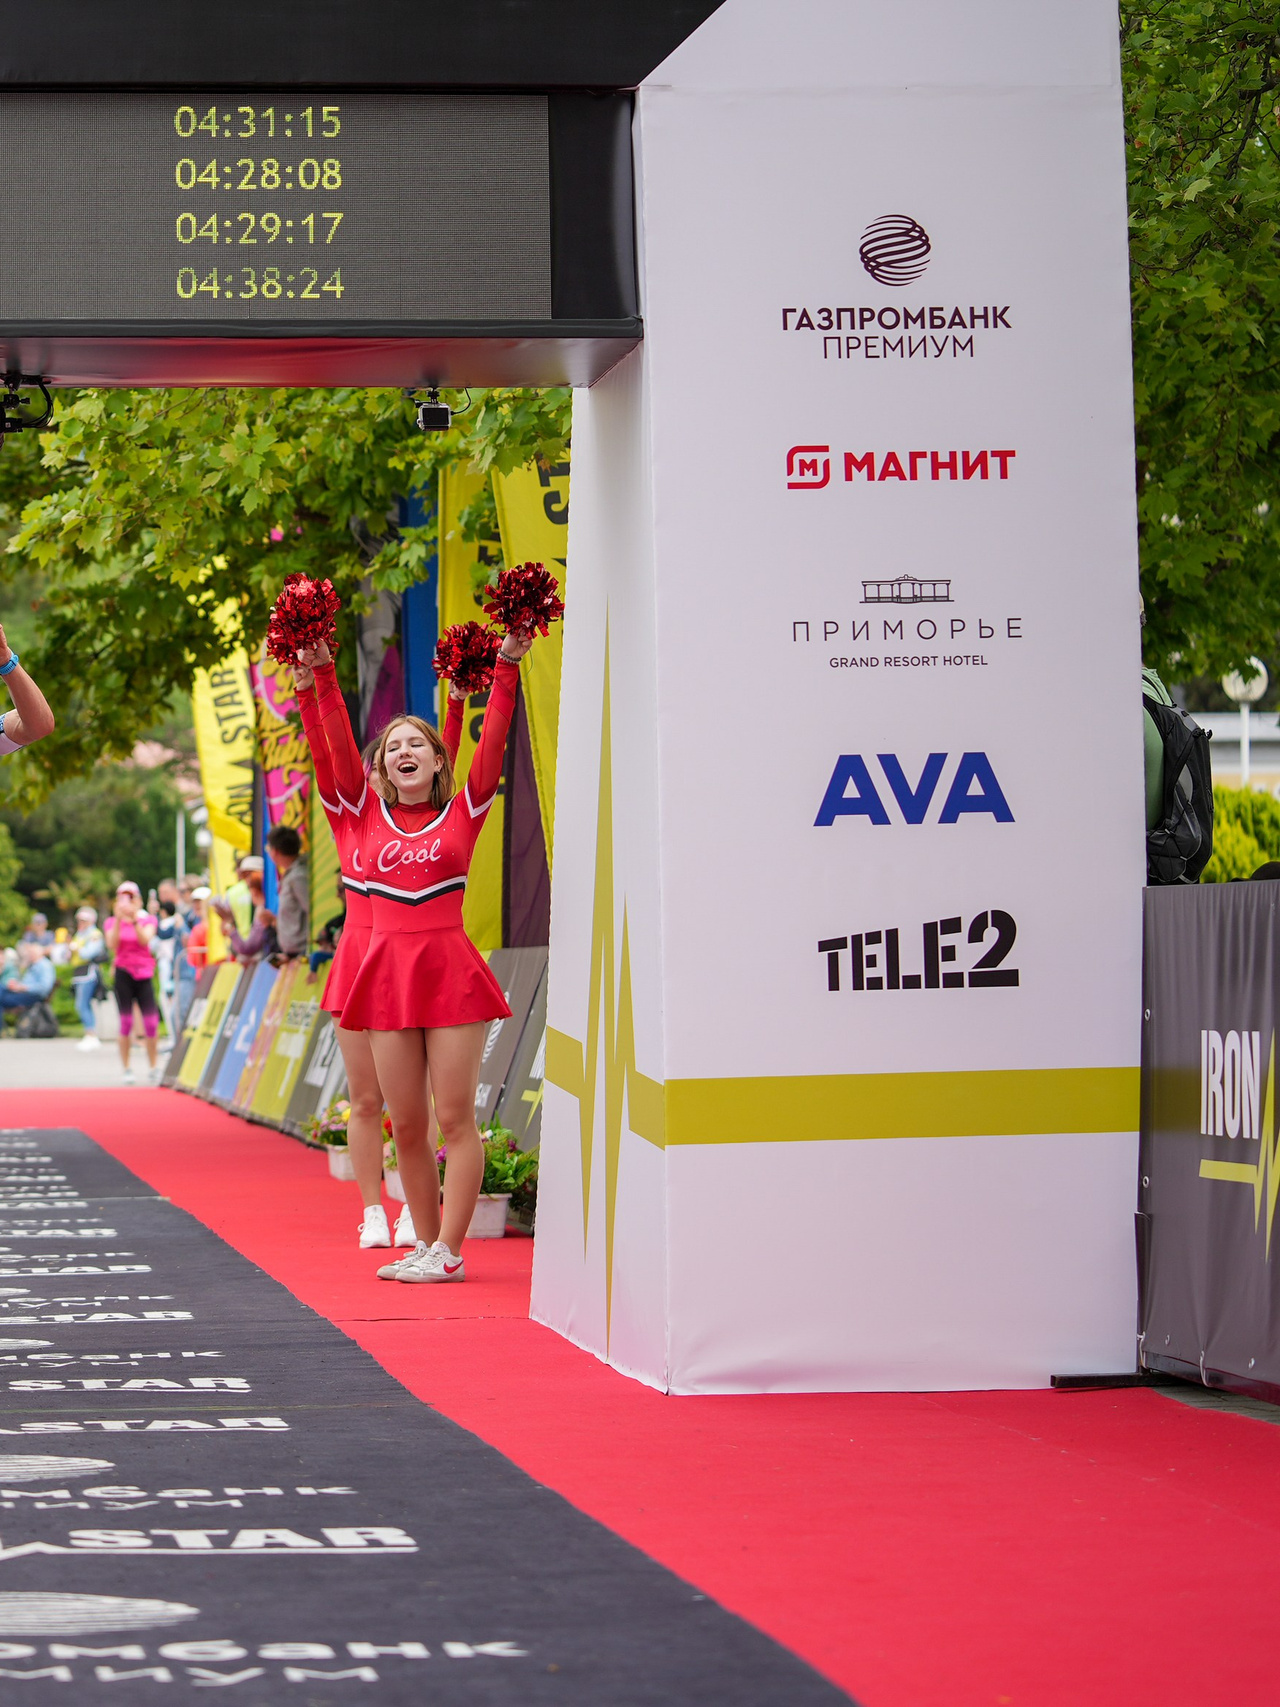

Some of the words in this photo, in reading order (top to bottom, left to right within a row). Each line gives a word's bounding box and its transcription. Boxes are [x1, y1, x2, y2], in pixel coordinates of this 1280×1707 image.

[174, 106, 341, 137] 04:31:15
[175, 159, 342, 190] 04:28:08
[176, 213, 344, 244] 04:29:17
[177, 267, 345, 299] 04:38:24
[781, 306, 1012, 331] ГАЗПРОМБАНК
[823, 335, 974, 359] ПРЕМИУМ
[843, 450, 1016, 482] МАГНИТ
[792, 617, 1023, 642] ПРИМОРЬЕ
[829, 657, 879, 668] GRAND
[883, 656, 939, 667] RESORT
[943, 655, 988, 666] HOTEL
[813, 752, 1015, 826] AVA
[377, 838, 441, 872] Cool
[818, 910, 1019, 991] TELE2
[1201, 1030, 1260, 1139] IRON
[9, 1377, 251, 1389] STAR
[20, 1417, 289, 1430] STAR
[68, 1526, 418, 1549] STAR
